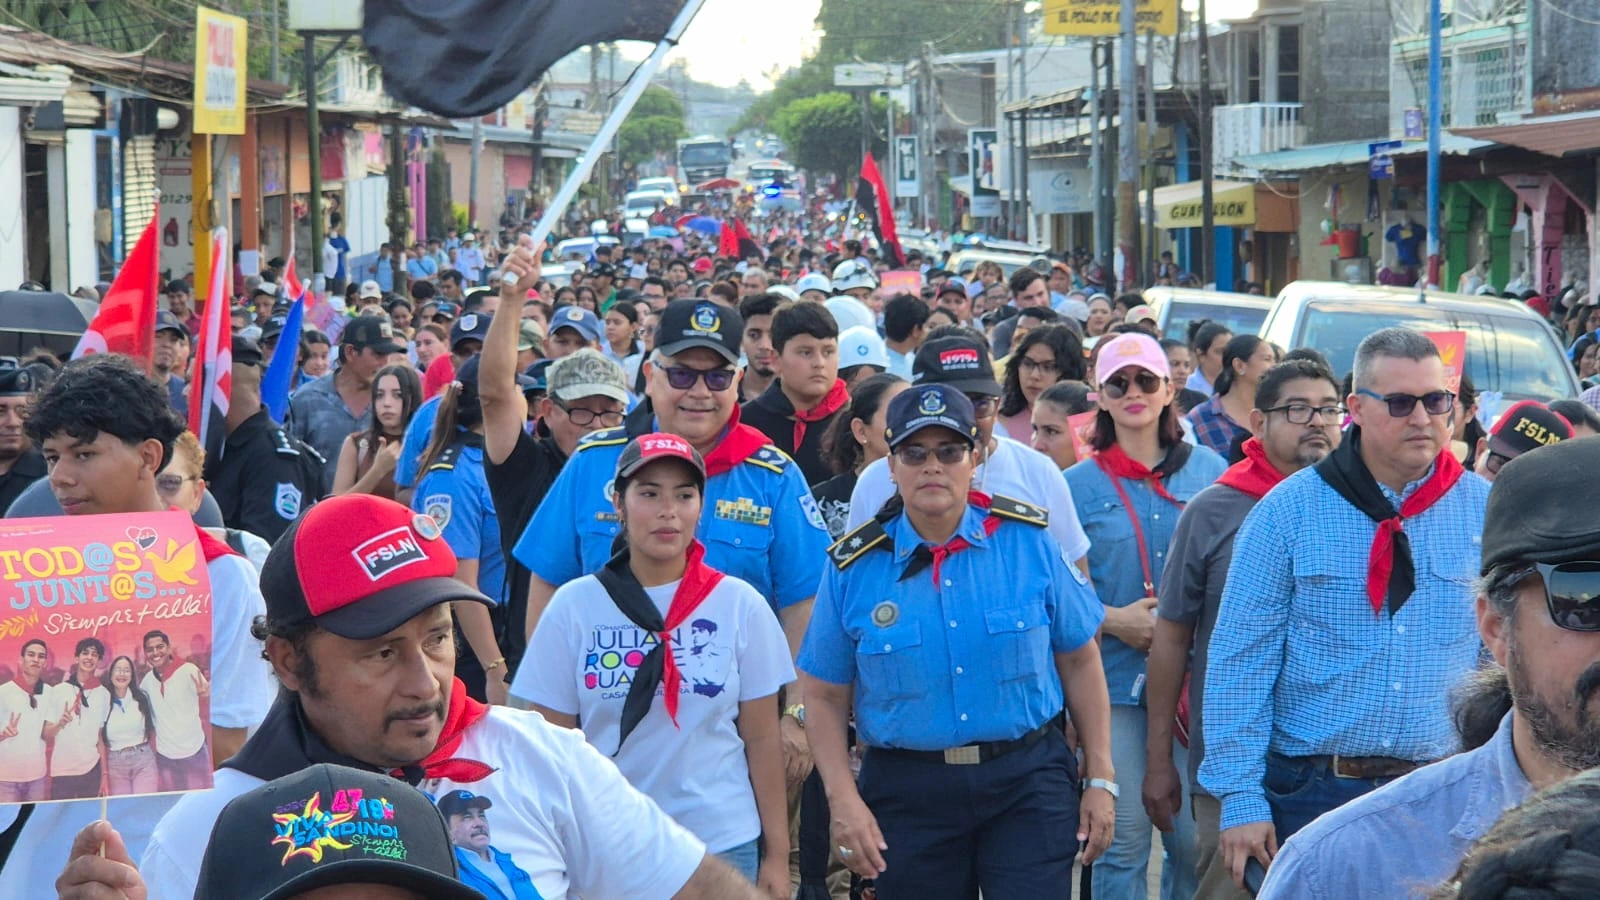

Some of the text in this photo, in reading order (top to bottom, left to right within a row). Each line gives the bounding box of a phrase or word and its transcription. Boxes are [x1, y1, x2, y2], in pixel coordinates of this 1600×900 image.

[644, 438, 688, 454] FSLN
[1513, 417, 1561, 447] FSLN
[0, 541, 143, 580] TOD@S
[364, 536, 417, 569] FSLN
[331, 789, 364, 812] 47
[273, 810, 334, 837] VIVA
